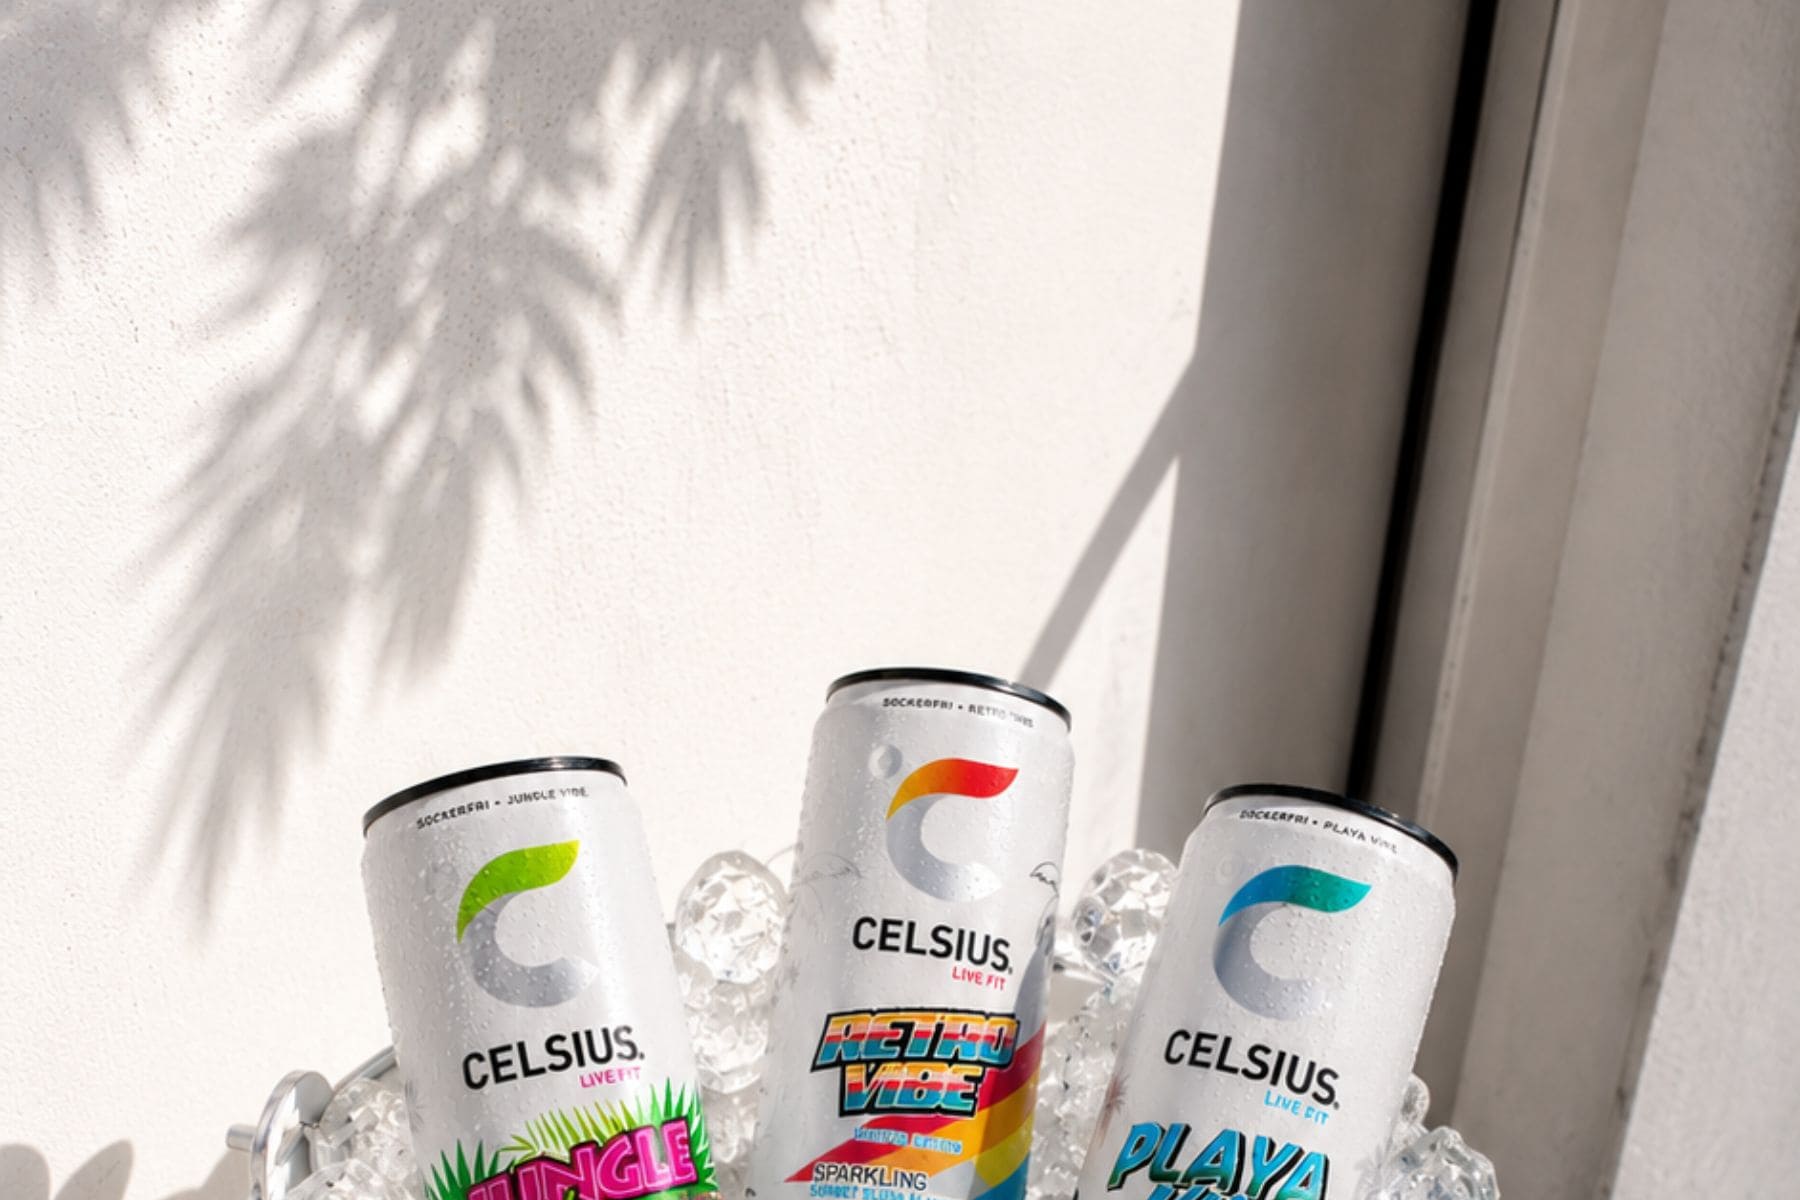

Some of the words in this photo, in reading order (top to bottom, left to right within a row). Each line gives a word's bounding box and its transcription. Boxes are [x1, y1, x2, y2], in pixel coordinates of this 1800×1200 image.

[951, 965, 983, 986] LIVE
[810, 1006, 1021, 1073] RETRO
[579, 1068, 618, 1089] LIVE
[839, 1060, 987, 1118] VIBE
[1263, 1089, 1302, 1117] LIVE
[813, 1163, 927, 1192] SPARKLING
